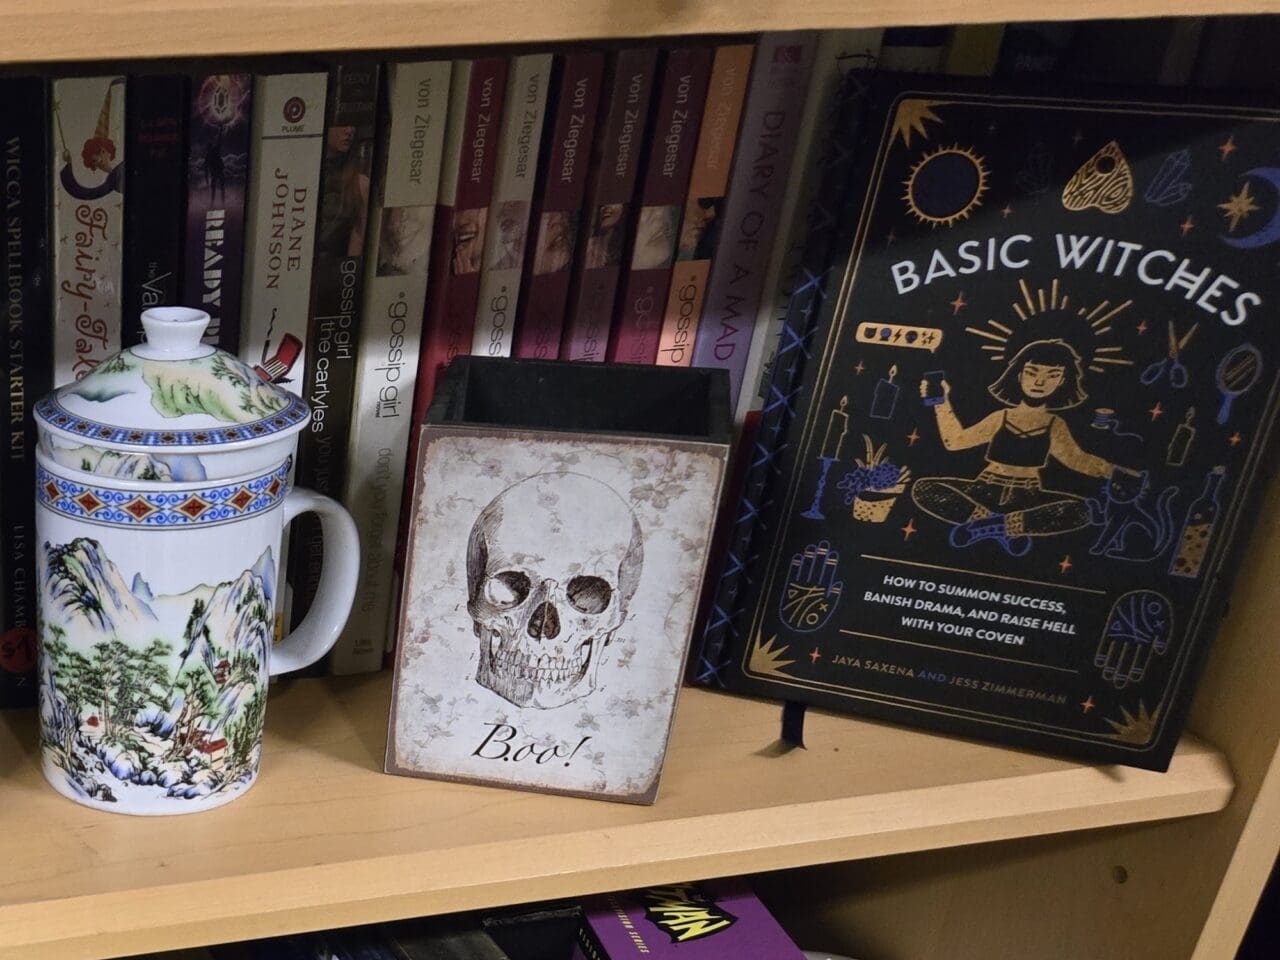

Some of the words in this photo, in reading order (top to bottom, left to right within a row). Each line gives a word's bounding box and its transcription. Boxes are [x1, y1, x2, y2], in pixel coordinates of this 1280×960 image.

[418, 78, 433, 109] von
[480, 77, 495, 108] von
[524, 74, 539, 104] von
[574, 78, 589, 109] von
[629, 74, 644, 105] von
[677, 74, 692, 105] von
[280, 124, 306, 134] PLUME
[409, 112, 432, 186] Ziegesar
[470, 111, 492, 185] Ziegesar
[514, 110, 537, 180] Ziegesar
[560, 111, 586, 184] Ziegesar
[614, 110, 641, 180] Ziegesar
[661, 109, 690, 179] Ziegesar
[265, 167, 289, 290] JOHNSON
[285, 186, 308, 273] DIANE
[890, 233, 1034, 295] BASIC
[1055, 232, 1263, 327] WITCHES
[318, 319, 334, 353] the
[374, 299, 409, 383] gossip
[311, 355, 331, 433] carlyles
[379, 384, 401, 419] girl
[863, 591, 913, 608] BANISH
[913, 599, 967, 618] DRAMA,
[967, 607, 1000, 623] AND
[1000, 612, 1041, 630] RAISE
[1041, 619, 1077, 635] HELL
[882, 574, 918, 591] HOW
[919, 579, 937, 593] TO
[937, 583, 1001, 603] SUMMON
[1002, 593, 1068, 615] SUCCESS,
[901, 615, 935, 631] WITH
[936, 621, 975, 638] YOUR
[975, 629, 1026, 646] COVEN
[831, 654, 861, 669] JAYA
[863, 659, 915, 679] SAXENA
[917, 670, 947, 684] AND
[948, 676, 979, 690] JESS
[980, 681, 1068, 706] ZIMMERMAN
[471, 721, 593, 768] Boo!
